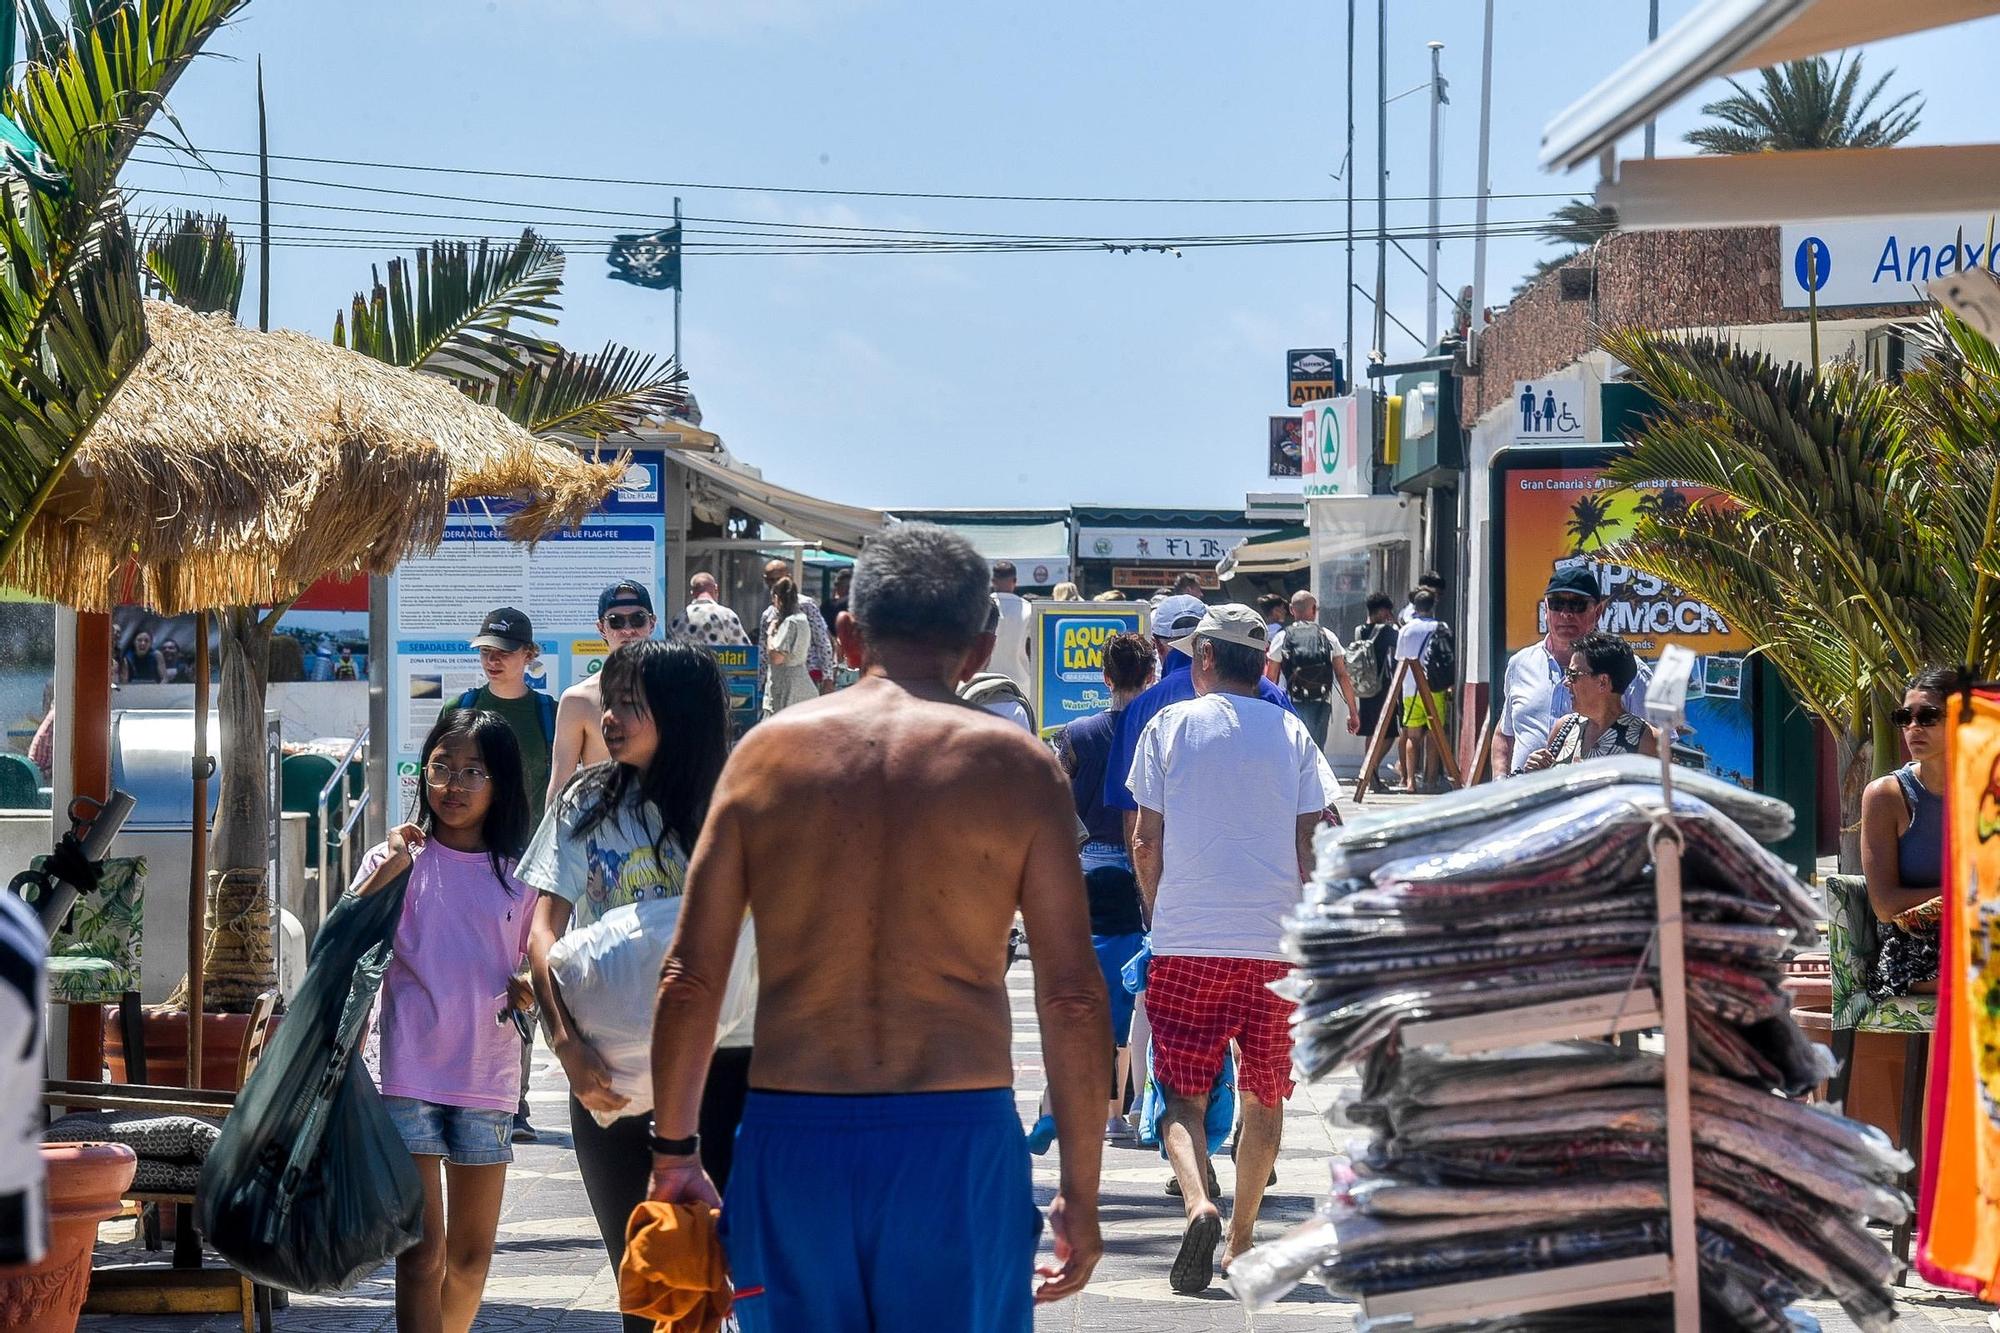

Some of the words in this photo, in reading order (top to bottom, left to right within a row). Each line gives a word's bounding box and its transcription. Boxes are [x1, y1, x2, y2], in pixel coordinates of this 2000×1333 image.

[1293, 385, 1333, 401] ATM
[1520, 479, 1544, 490] Gran
[1652, 478, 1669, 488] Bar
[1671, 479, 1679, 488] &
[638, 492, 656, 500] FLAG
[562, 530, 583, 539] BLUE
[584, 530, 619, 539] FLAG-FEE
[409, 643, 456, 652] SEBADALES
[718, 650, 746, 665] afari
[1063, 699, 1090, 710] Water
